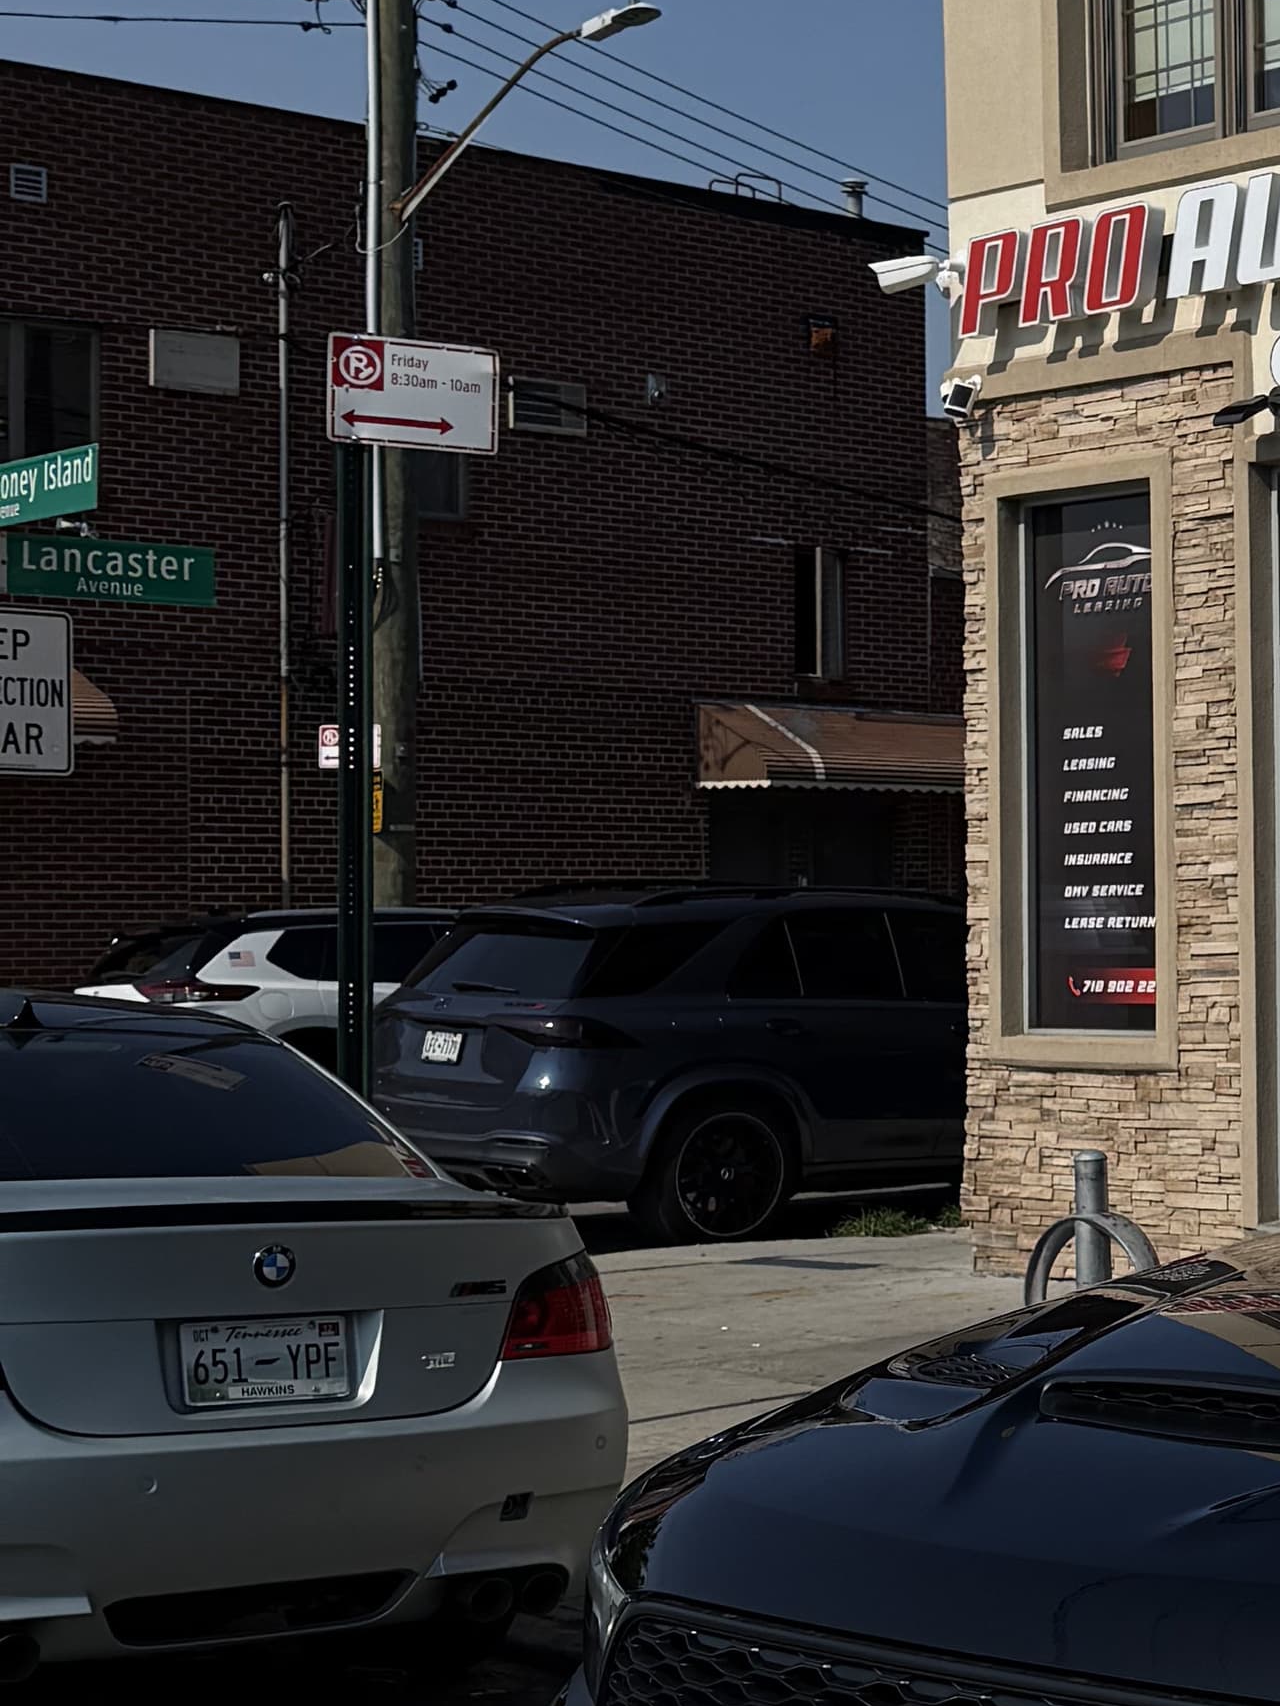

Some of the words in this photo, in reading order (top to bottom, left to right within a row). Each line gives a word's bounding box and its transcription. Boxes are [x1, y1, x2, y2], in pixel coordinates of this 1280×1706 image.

[959, 202, 1150, 337] PRO
[391, 353, 429, 371] Friday
[391, 373, 437, 390] 8:30am
[450, 379, 481, 394] 10am
[0, 467, 38, 503] oney
[44, 447, 93, 491] Island
[0, 502, 20, 519] enue
[23, 541, 195, 582] Lancaster
[77, 577, 143, 597] Avenue
[1059, 577, 1100, 601] PRO
[1073, 597, 1143, 614] LEASING
[2, 722, 43, 755] AR
[1063, 725, 1103, 741] SALES
[1063, 757, 1116, 772] LEASING
[1063, 788, 1129, 804] FINANCING
[1064, 821, 1096, 835] USED
[1099, 819, 1133, 834] CARS
[1064, 851, 1134, 867] INSURANCE
[1064, 885, 1089, 899] DMV
[1092, 883, 1144, 898] SERVICE
[1064, 916, 1105, 930] LEASE
[1107, 979, 1133, 994] 902
[1137, 979, 1155, 993] 22
[193, 1328, 209, 1342] OCT
[225, 1325, 303, 1343] Tennessee
[241, 1383, 295, 1397] HAWKINS
